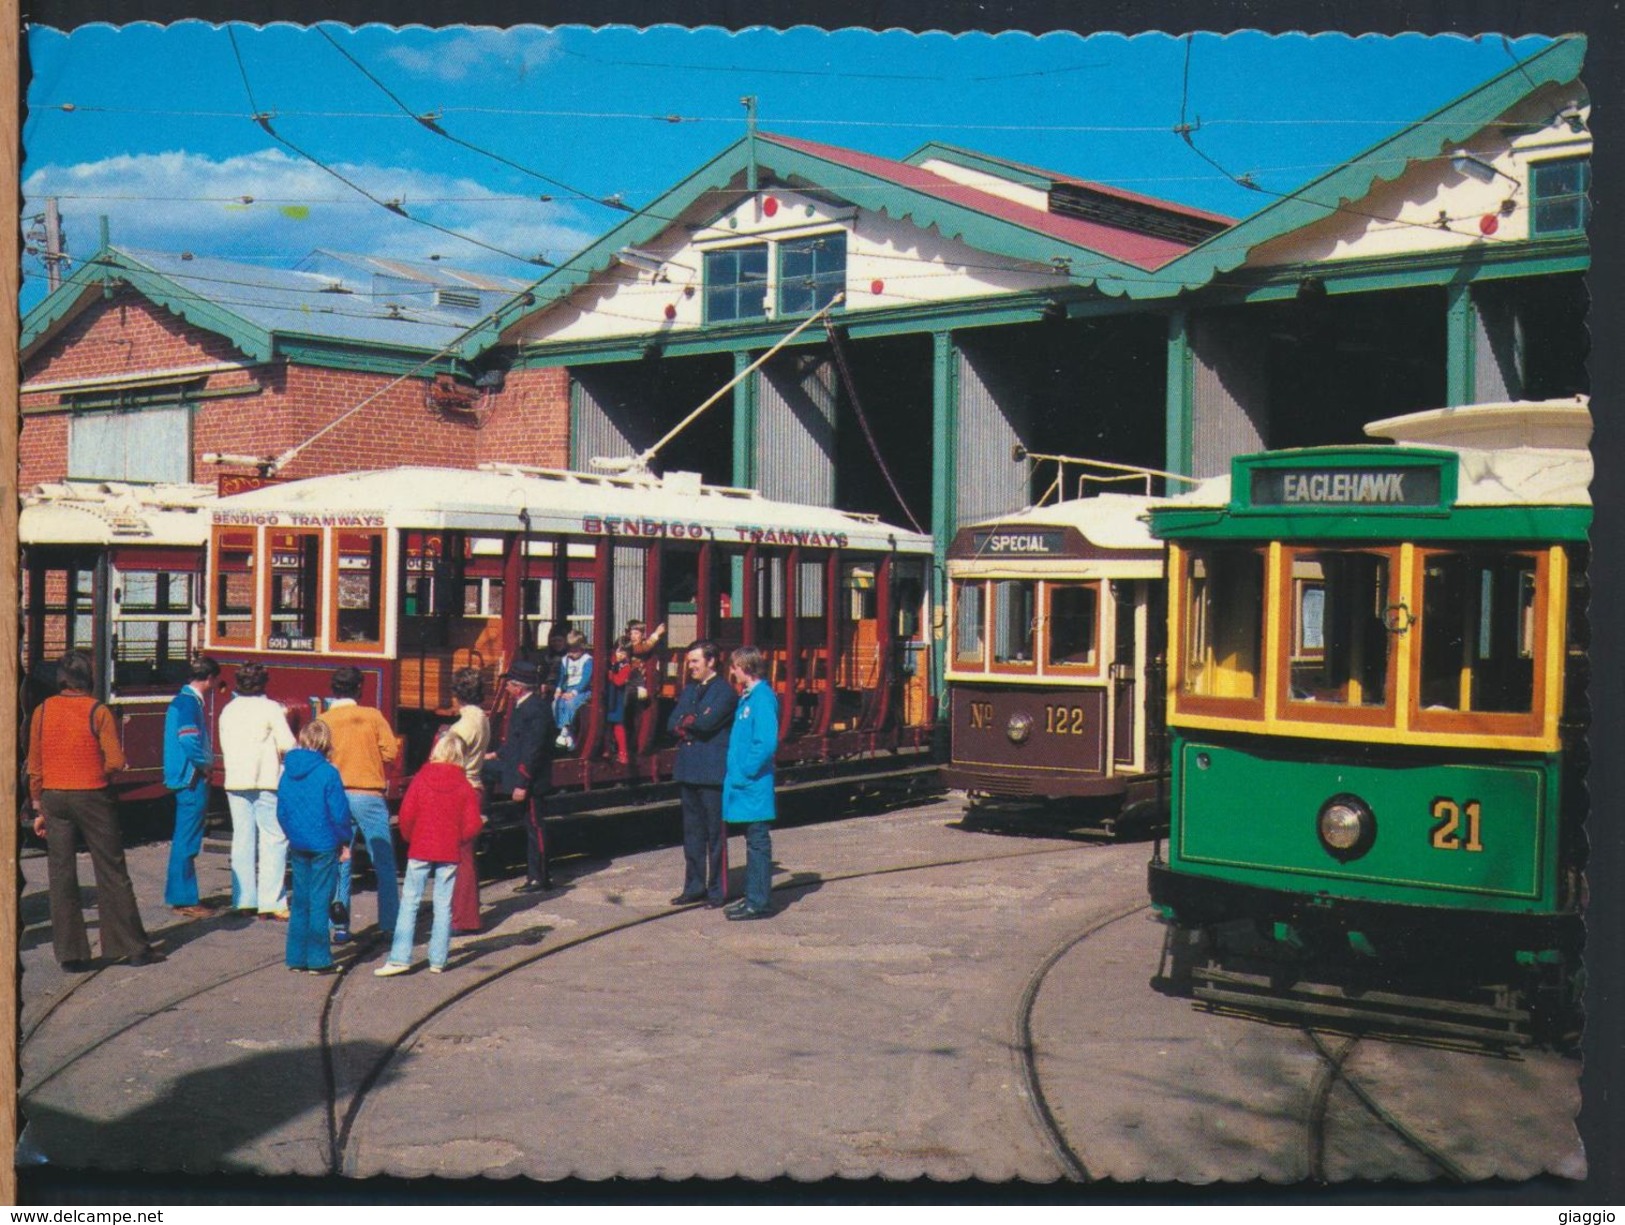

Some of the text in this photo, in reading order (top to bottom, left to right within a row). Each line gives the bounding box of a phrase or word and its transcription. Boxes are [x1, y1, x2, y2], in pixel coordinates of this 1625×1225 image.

[1283, 473, 1406, 503] EAGLEHAWK
[212, 512, 386, 527] BENDIGO TRAMWAYS
[582, 514, 849, 548] BENDIGO TRAMWAYS
[990, 535, 1049, 552] SPECIAL
[268, 638, 289, 650] GOLD
[1045, 705, 1084, 734] 122
[1429, 797, 1484, 853] 21
